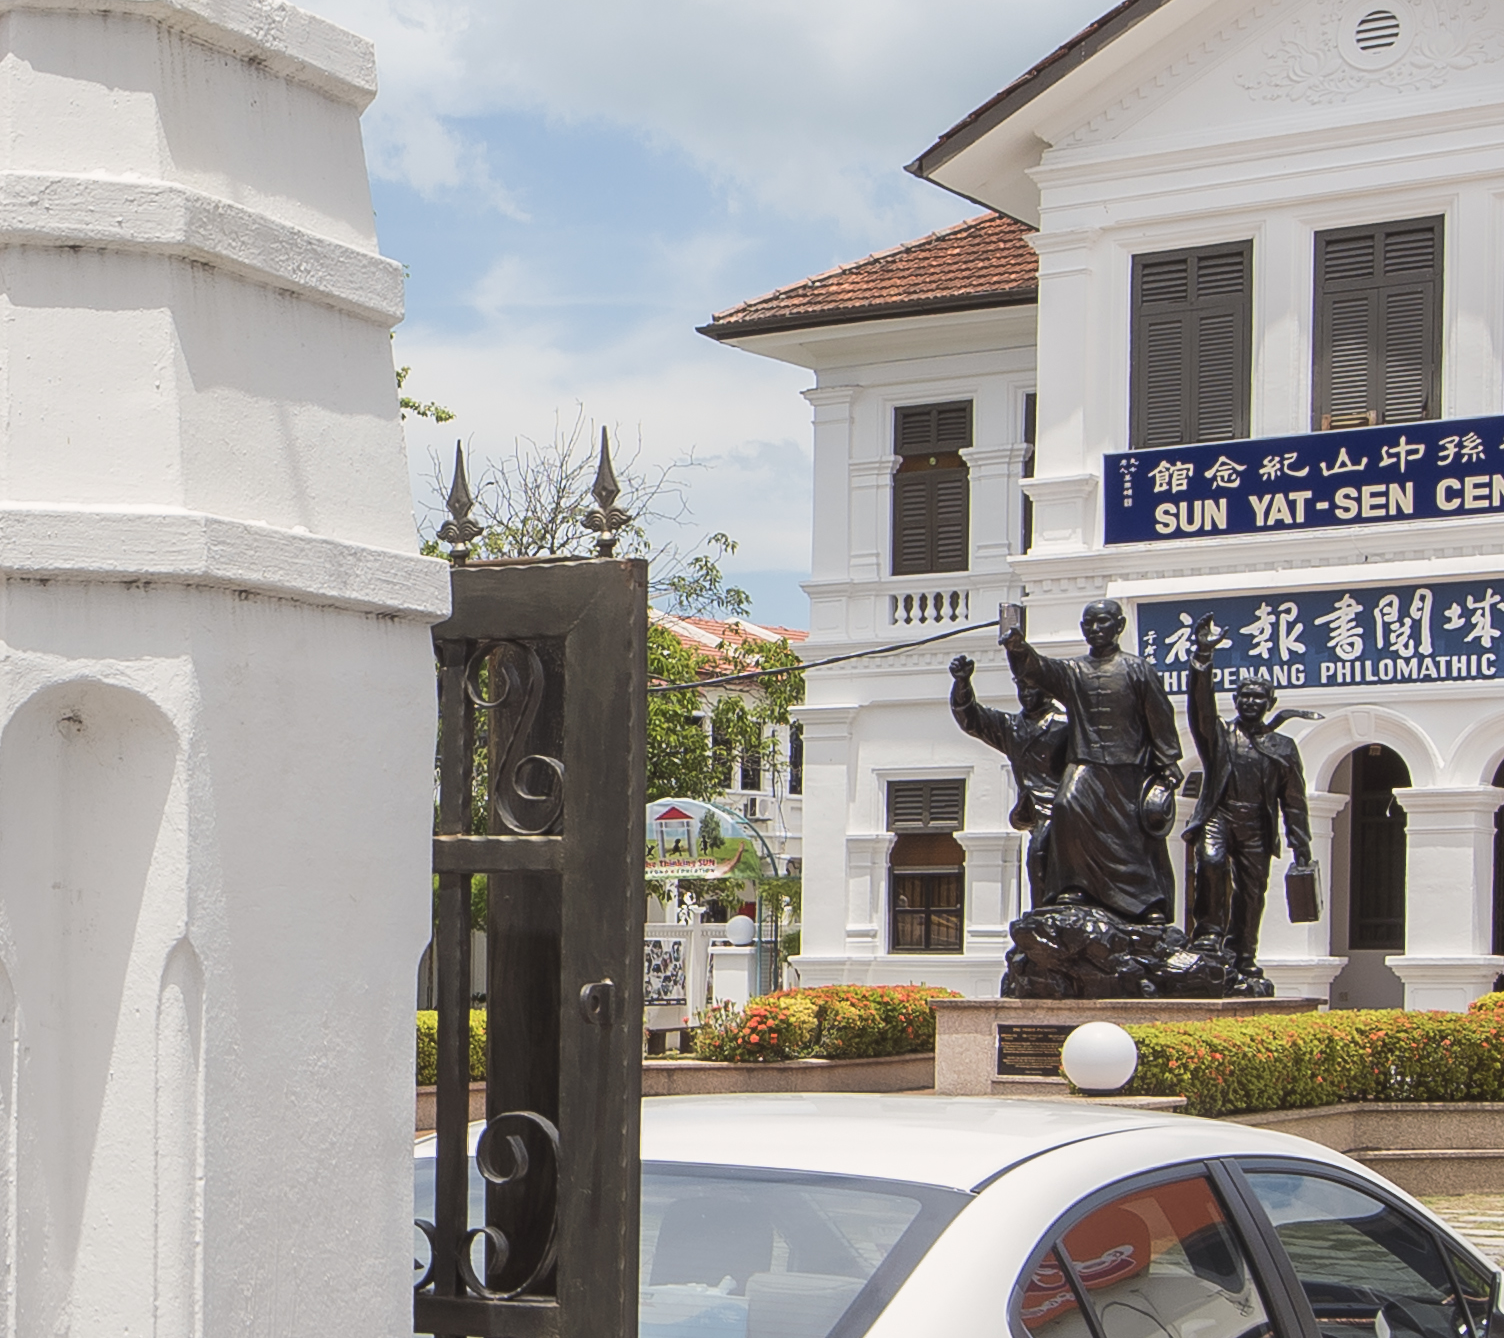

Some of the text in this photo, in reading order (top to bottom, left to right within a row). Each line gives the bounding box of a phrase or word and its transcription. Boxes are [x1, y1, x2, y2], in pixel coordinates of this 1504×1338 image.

[1154, 497, 1227, 534] SUN
[1248, 481, 1414, 526] YAT-SEN
[1320, 653, 1497, 684] PHILOMATHIC
